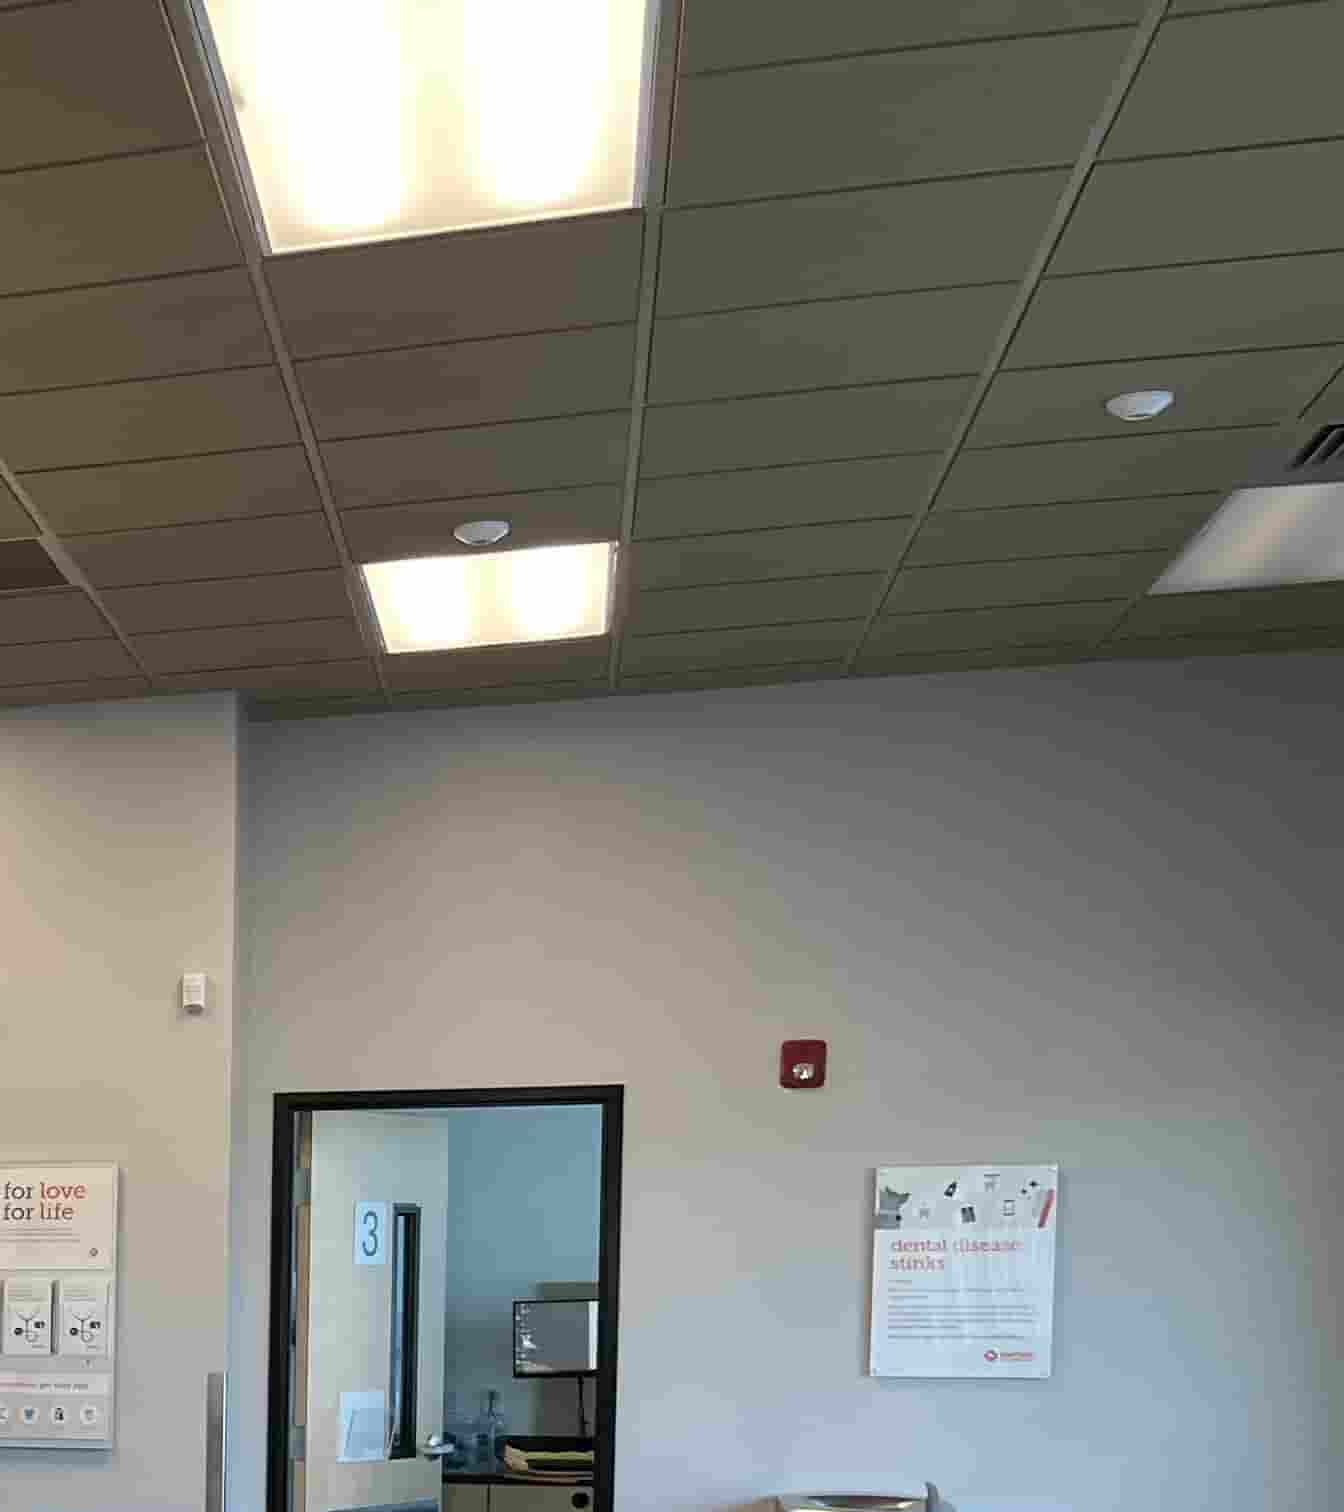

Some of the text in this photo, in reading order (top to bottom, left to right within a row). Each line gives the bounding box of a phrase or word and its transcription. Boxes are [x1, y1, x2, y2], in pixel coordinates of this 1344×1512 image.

[4, 1181, 86, 1200] for love
[3, 1201, 73, 1221] for life
[362, 1210, 378, 1257] 3
